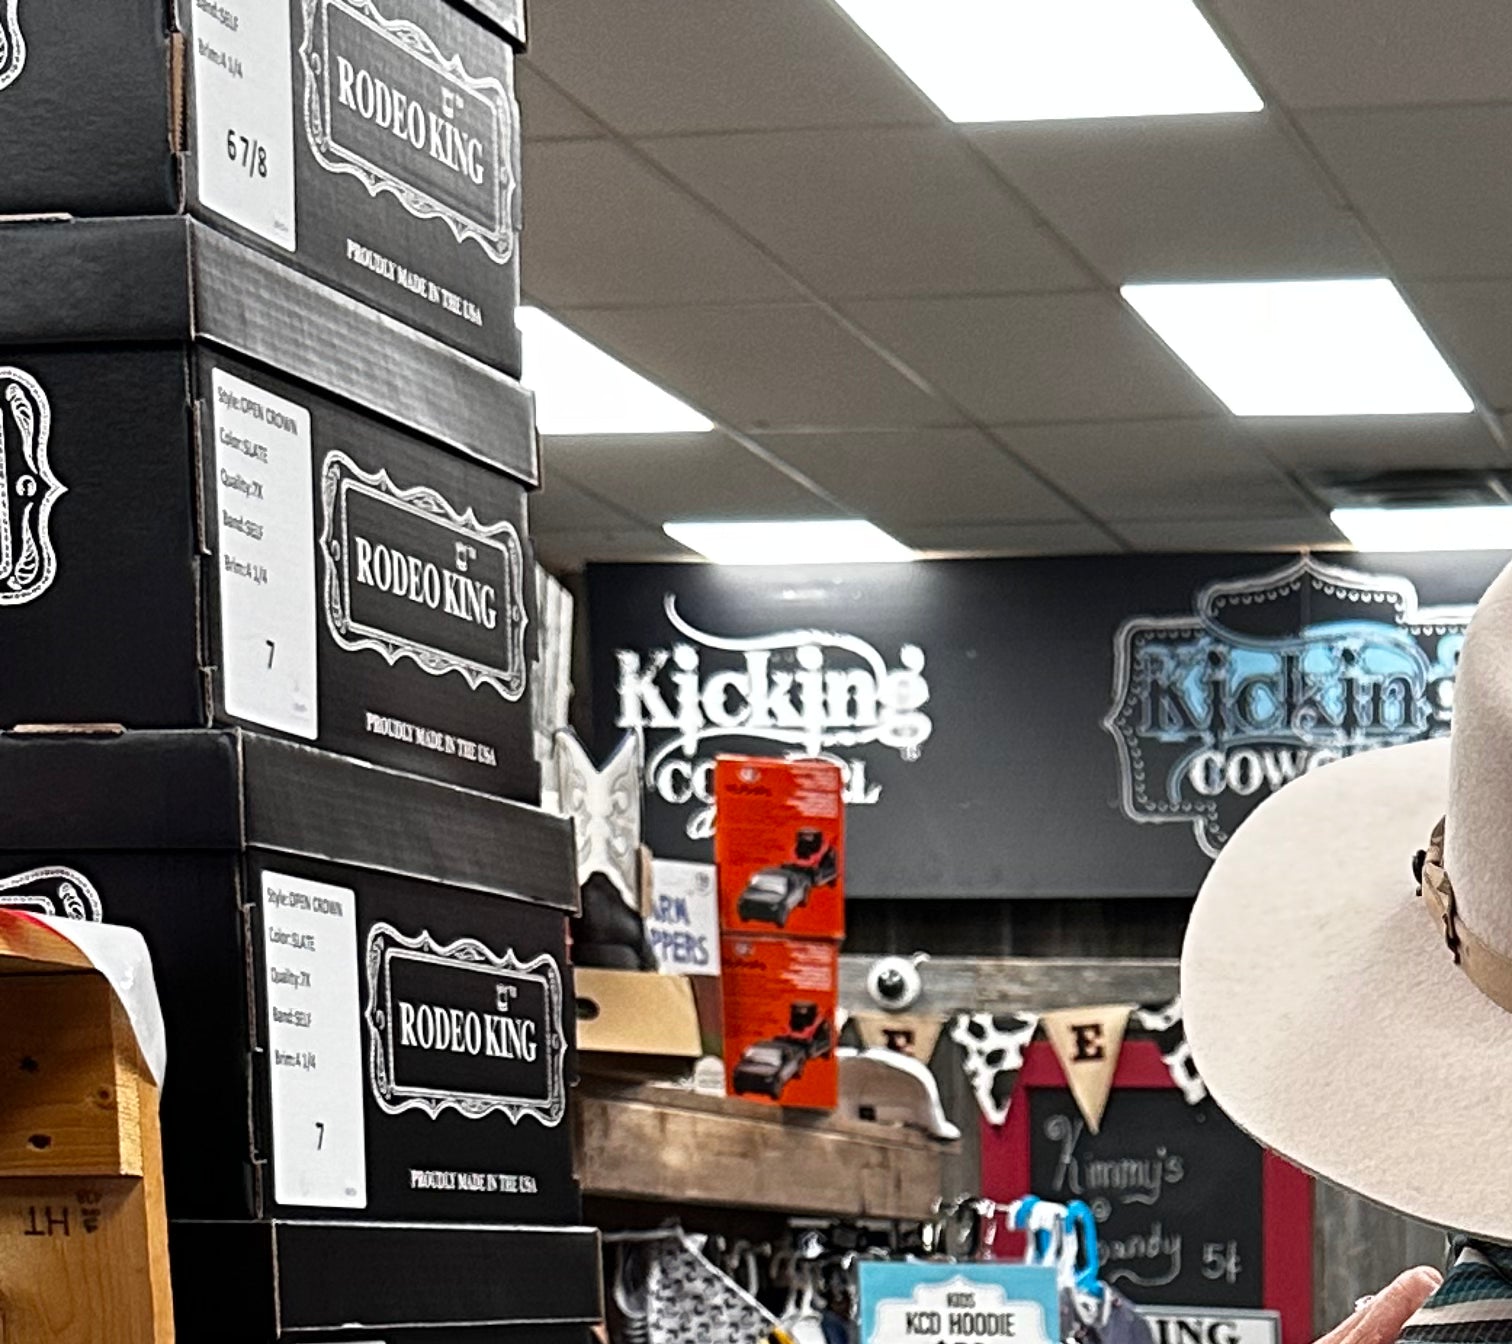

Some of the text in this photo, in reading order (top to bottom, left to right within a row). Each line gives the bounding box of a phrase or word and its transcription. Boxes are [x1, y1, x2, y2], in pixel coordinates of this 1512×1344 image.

[337, 57, 484, 184] RODEO KING
[226, 129, 268, 178] 6 7/8
[355, 537, 497, 630] RODEO KING
[265, 640, 275, 669] 7
[615, 640, 933, 756] Kicking
[399, 1001, 537, 1062] RODEO KING
[1069, 1023, 1104, 1062] E
[315, 1121, 324, 1150] 7
[1044, 1113, 1184, 1205] Kimmy's
[905, 1311, 1016, 1337] KCD HOODIE
